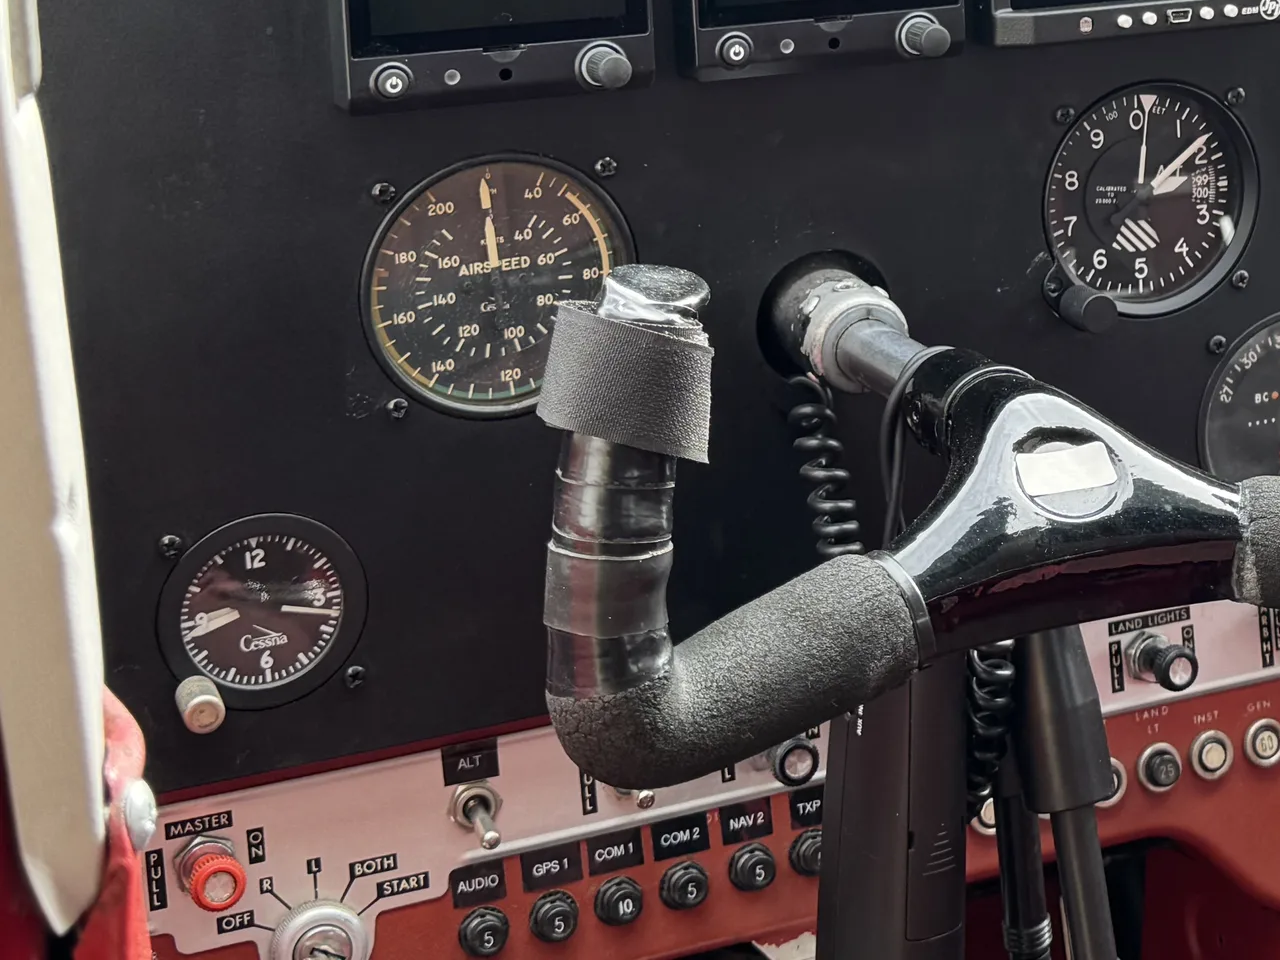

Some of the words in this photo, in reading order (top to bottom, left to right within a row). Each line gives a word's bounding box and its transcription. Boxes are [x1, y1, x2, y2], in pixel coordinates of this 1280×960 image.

[1242, 7, 1259, 15] EDM
[1105, 111, 1119, 121] 100
[1129, 109, 1143, 130] 0
[1090, 128, 1104, 149] 9
[1195, 144, 1208, 164] 2
[1064, 170, 1079, 190] 8
[524, 187, 543, 199] 40
[427, 202, 455, 216] 200
[1196, 204, 1210, 225] 3
[563, 214, 580, 226] 60
[1063, 216, 1077, 237] 7
[514, 229, 532, 241] 40
[1174, 237, 1189, 257] 4
[394, 252, 417, 264] 180
[438, 256, 460, 269] 160
[537, 253, 555, 265] 60
[1092, 249, 1107, 269] 6
[583, 269, 599, 280] 80
[1134, 257, 1148, 279] 5
[433, 293, 456, 306] 140
[536, 294, 553, 307] 80
[394, 311, 416, 324] 160
[459, 324, 480, 337] 120
[504, 326, 525, 339] 100
[432, 359, 455, 372] 140
[1242, 350, 1258, 370] 30
[501, 368, 521, 381] 120
[1220, 385, 1234, 404] 27
[244, 548, 266, 570] 12
[311, 588, 326, 607] 3
[1111, 618, 1143, 634] LAND
[1148, 610, 1188, 627] LIGHTS
[240, 632, 288, 653] Cessna
[259, 650, 274, 668] 6
[1111, 643, 1121, 689] PULL
[1135, 705, 1170, 723] LAND
[1193, 709, 1220, 725] INST
[1259, 734, 1275, 752] 60
[457, 754, 482, 771] ALT
[1158, 762, 1175, 779] 25
[170, 813, 229, 837] MASTER
[729, 815, 755, 830] NAV
[756, 811, 765, 826] 2
[249, 831, 263, 858] ON
[661, 831, 691, 848] COM
[691, 827, 700, 841] 2
[594, 847, 625, 862] COM
[628, 842, 634, 857] 1
[311, 859, 319, 872] L
[354, 855, 395, 876] BOTH
[532, 859, 561, 877] GPS
[562, 857, 569, 871] 1
[756, 864, 765, 881] 5
[149, 852, 162, 906] PULL
[262, 879, 272, 891] R
[383, 873, 426, 894] START
[457, 874, 499, 892] AUDIO
[686, 881, 697, 898] 5
[222, 912, 252, 930] OFF
[554, 916, 565, 933] 5
[484, 930, 494, 948] 5
